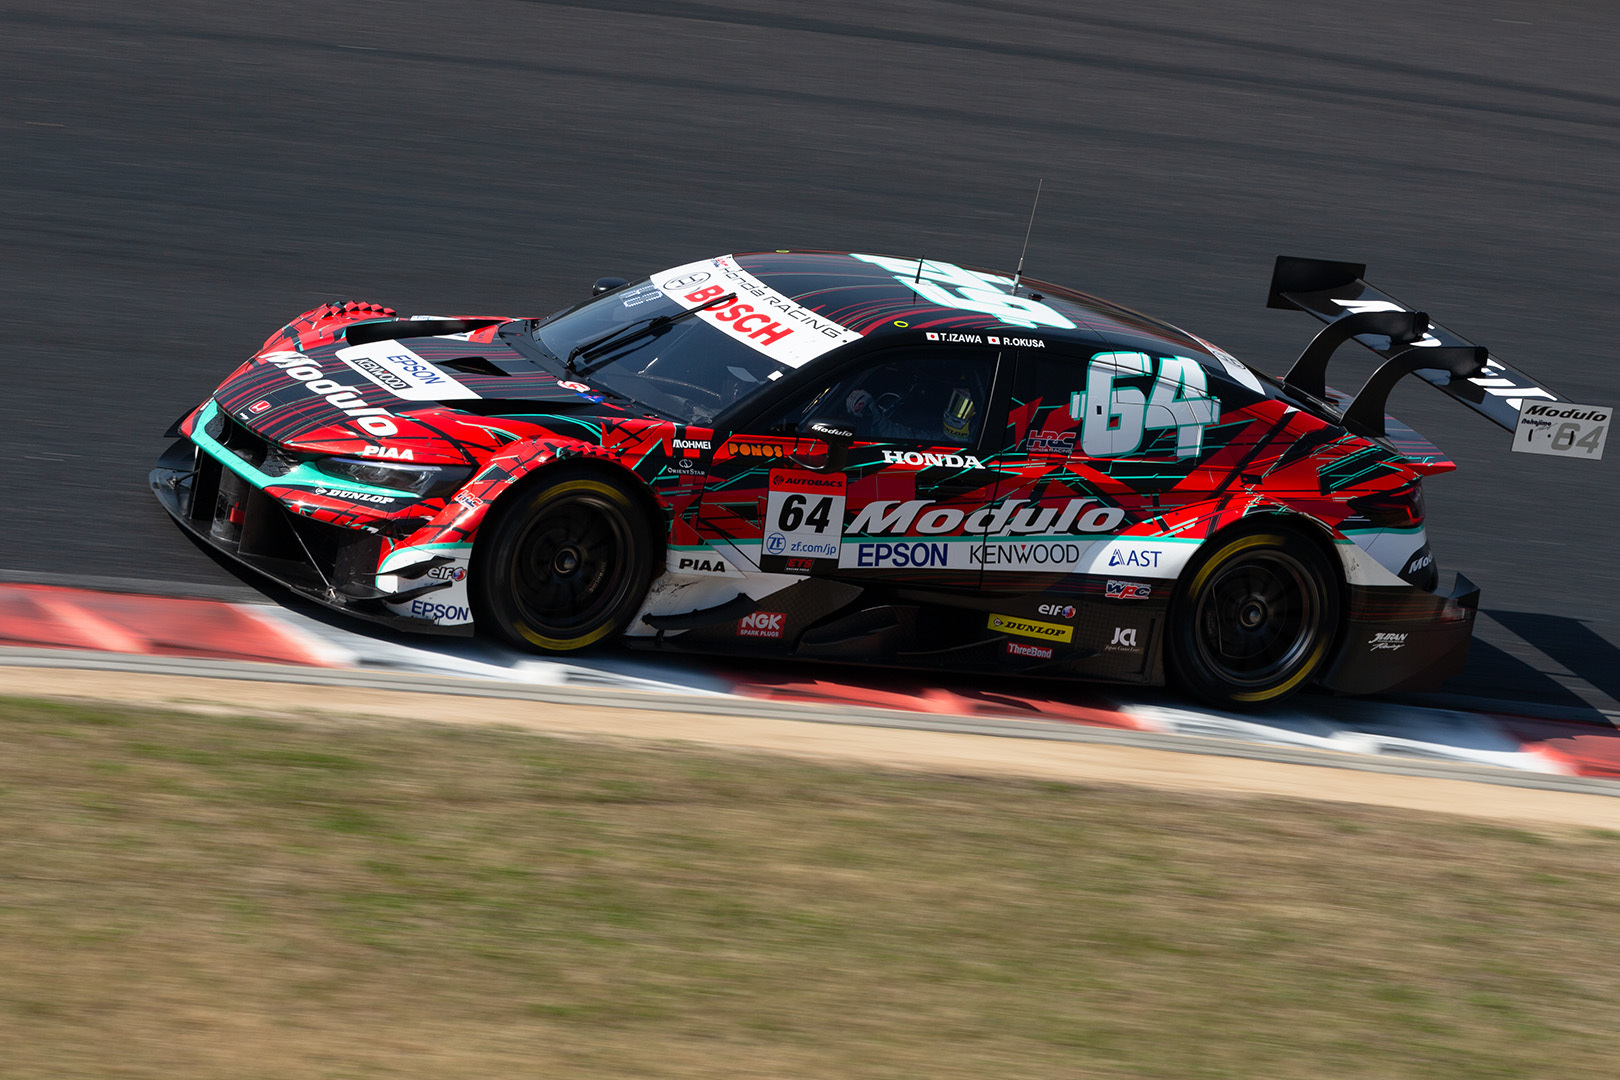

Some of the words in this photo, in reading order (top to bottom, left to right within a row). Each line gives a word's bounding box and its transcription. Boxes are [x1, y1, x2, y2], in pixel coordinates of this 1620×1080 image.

[684, 284, 795, 346] BOSCH
[763, 296, 841, 338] RACING
[939, 333, 982, 344] T.IZAWA
[1003, 337, 1045, 348] R.OKUSA
[355, 359, 408, 388] KENWOOD
[387, 354, 447, 384] EPSON
[258, 351, 398, 436] Modulo
[1070, 351, 1222, 458] 64
[1525, 405, 1607, 421] Modulo
[811, 424, 853, 437] Modulo
[1027, 430, 1077, 449] HRC
[1551, 422, 1605, 453] 64
[363, 445, 414, 460] PIAA
[728, 443, 783, 457] PONOS
[882, 450, 986, 469] HONDA
[785, 478, 843, 488] AUTOBACS
[327, 489, 395, 504] DUNLOP
[778, 494, 833, 534] 64
[844, 499, 1125, 535] Modulo
[791, 541, 837, 555] zf.com/jp
[857, 543, 948, 567] EPSON
[970, 543, 1080, 564] KENWOOD
[427, 567, 453, 580] elf
[679, 558, 726, 573] PIAA
[411, 600, 469, 621] EPSON
[1038, 604, 1062, 616] elf
[741, 612, 782, 630] NGK
[1004, 621, 1066, 637] DUNLOP
[1008, 643, 1052, 659] ThreeBond
